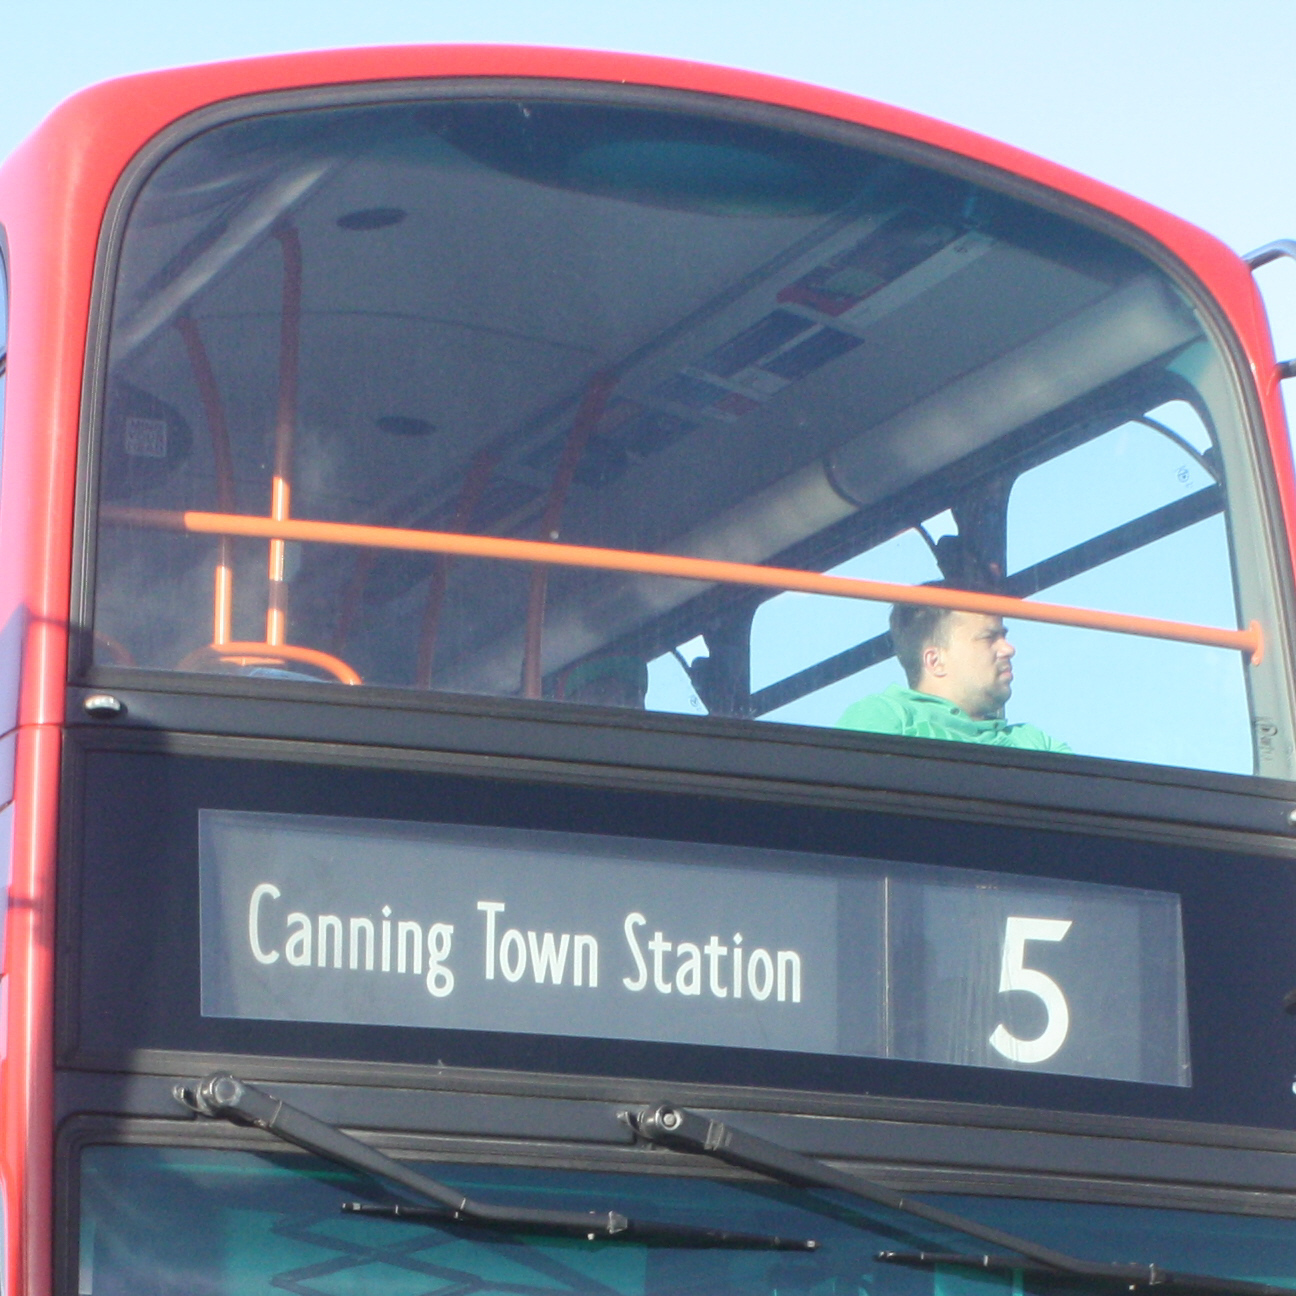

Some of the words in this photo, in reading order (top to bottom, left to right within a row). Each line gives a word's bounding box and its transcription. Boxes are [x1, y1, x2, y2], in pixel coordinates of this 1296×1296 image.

[248, 883, 455, 998] Canning
[477, 901, 599, 988] Town
[622, 912, 802, 1004] Station
[988, 915, 1074, 1065] 5
